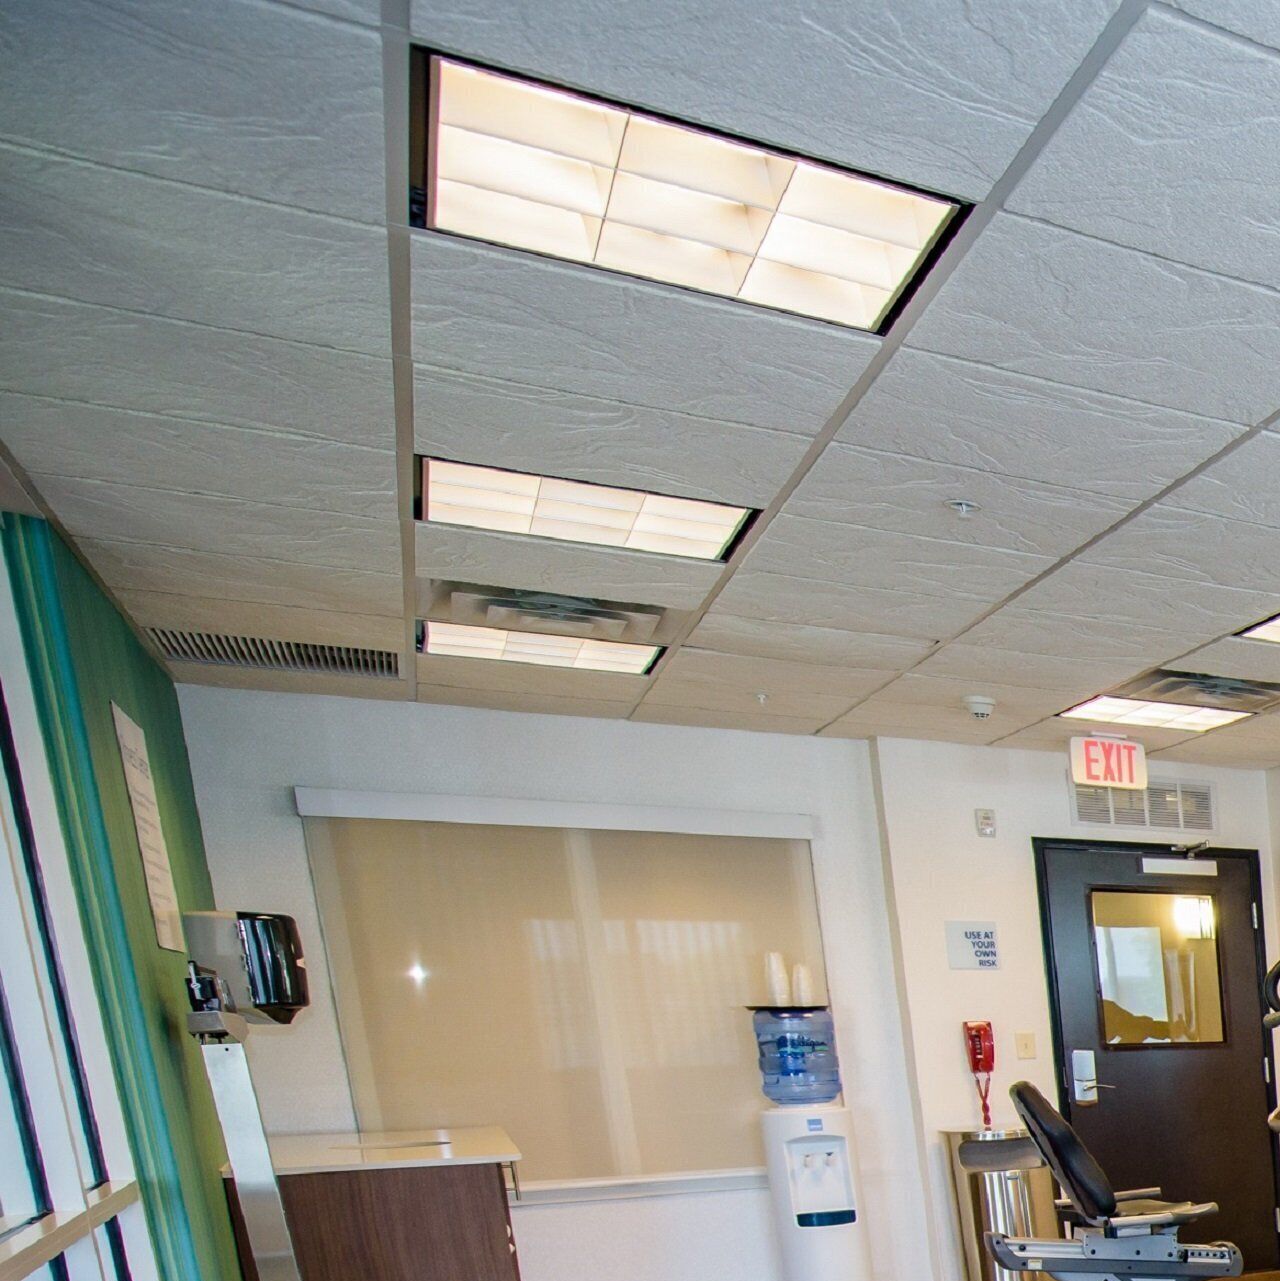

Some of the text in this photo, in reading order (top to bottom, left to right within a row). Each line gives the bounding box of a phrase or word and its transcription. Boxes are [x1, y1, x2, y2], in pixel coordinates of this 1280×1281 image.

[1083, 740, 1137, 783] EXIT
[964, 931, 994, 940] USE AT
[971, 940, 996, 949] YOUR
[974, 949, 997, 958] OWN
[978, 959, 997, 967] RISK
